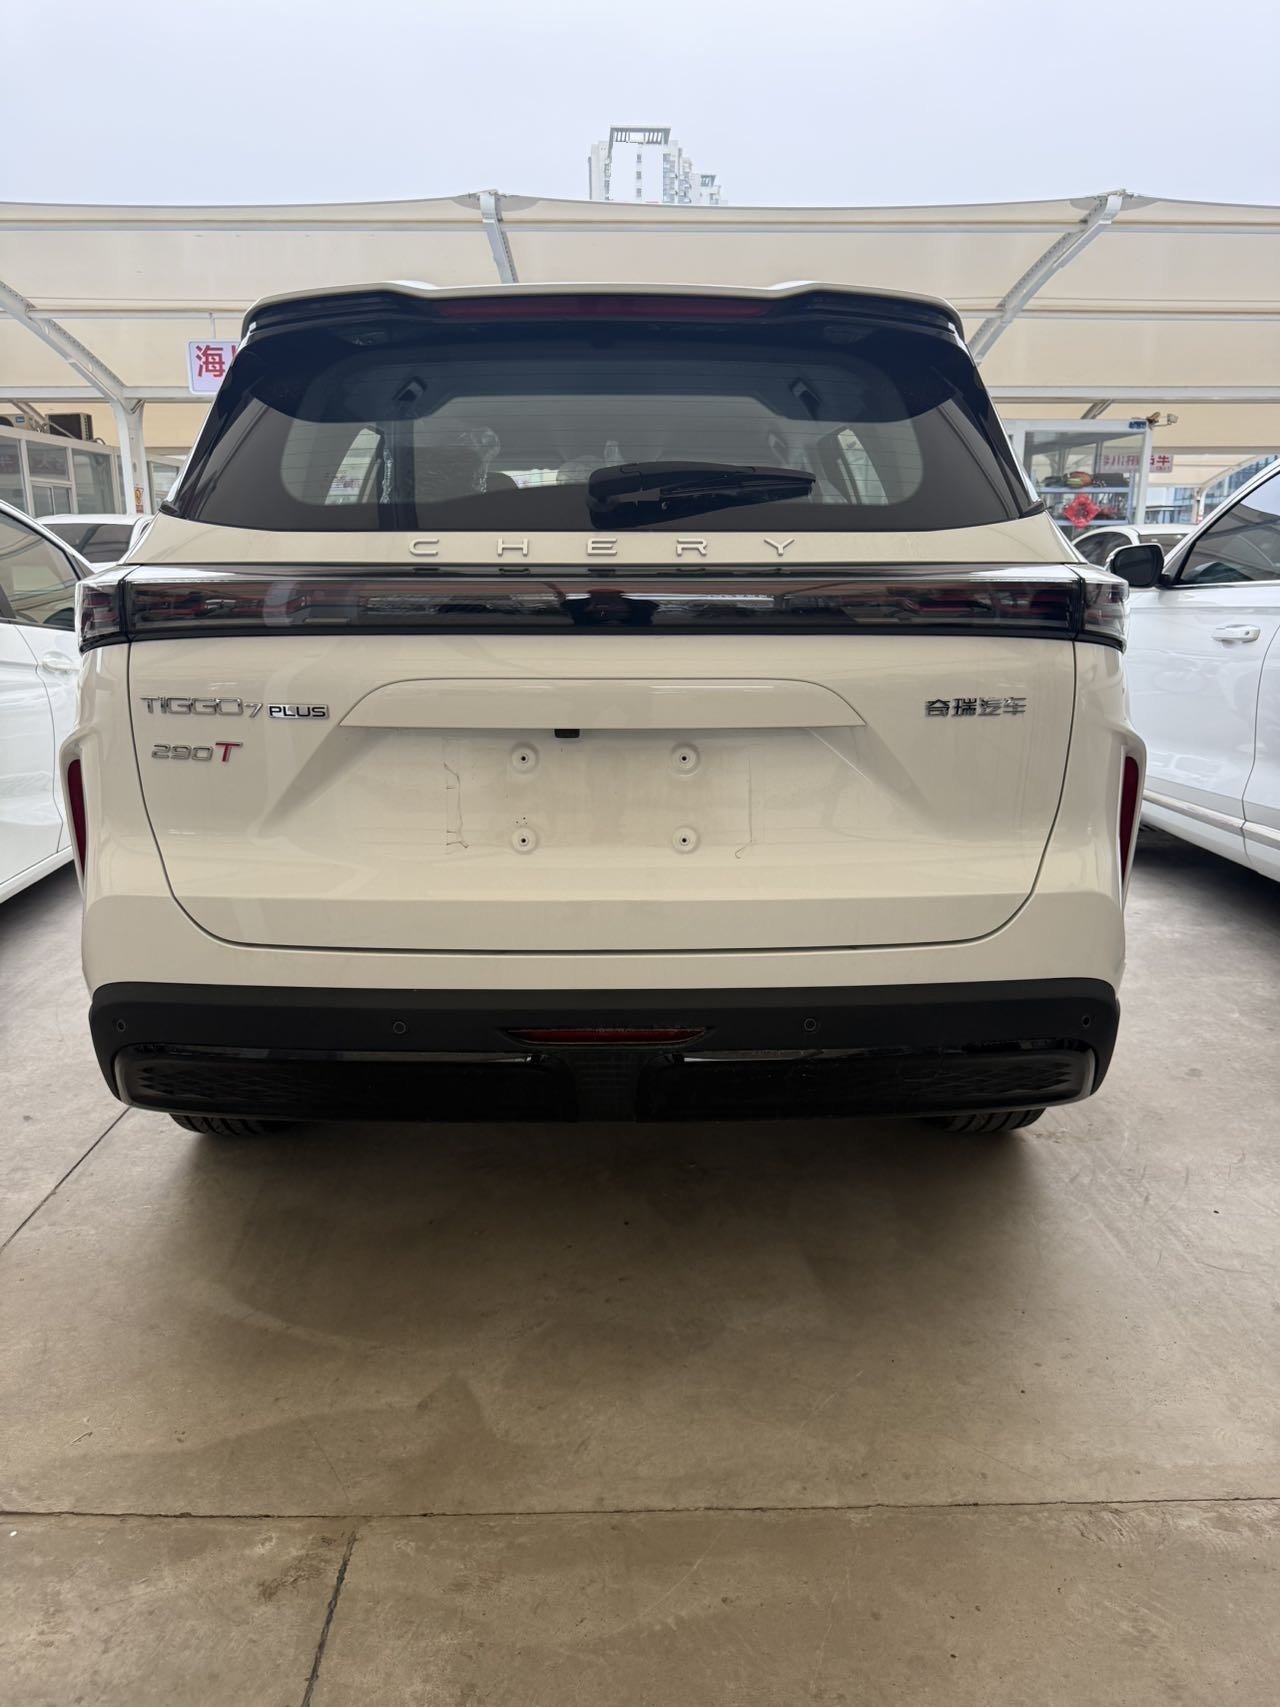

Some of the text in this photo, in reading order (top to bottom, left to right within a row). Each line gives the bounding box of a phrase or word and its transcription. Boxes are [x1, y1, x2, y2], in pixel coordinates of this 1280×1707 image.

[195, 344, 237, 378] 海
[408, 537, 795, 558] CHERY
[269, 706, 327, 718] PLUS
[925, 697, 1027, 718] 奇瑞汽车
[151, 741, 244, 763] 290T
